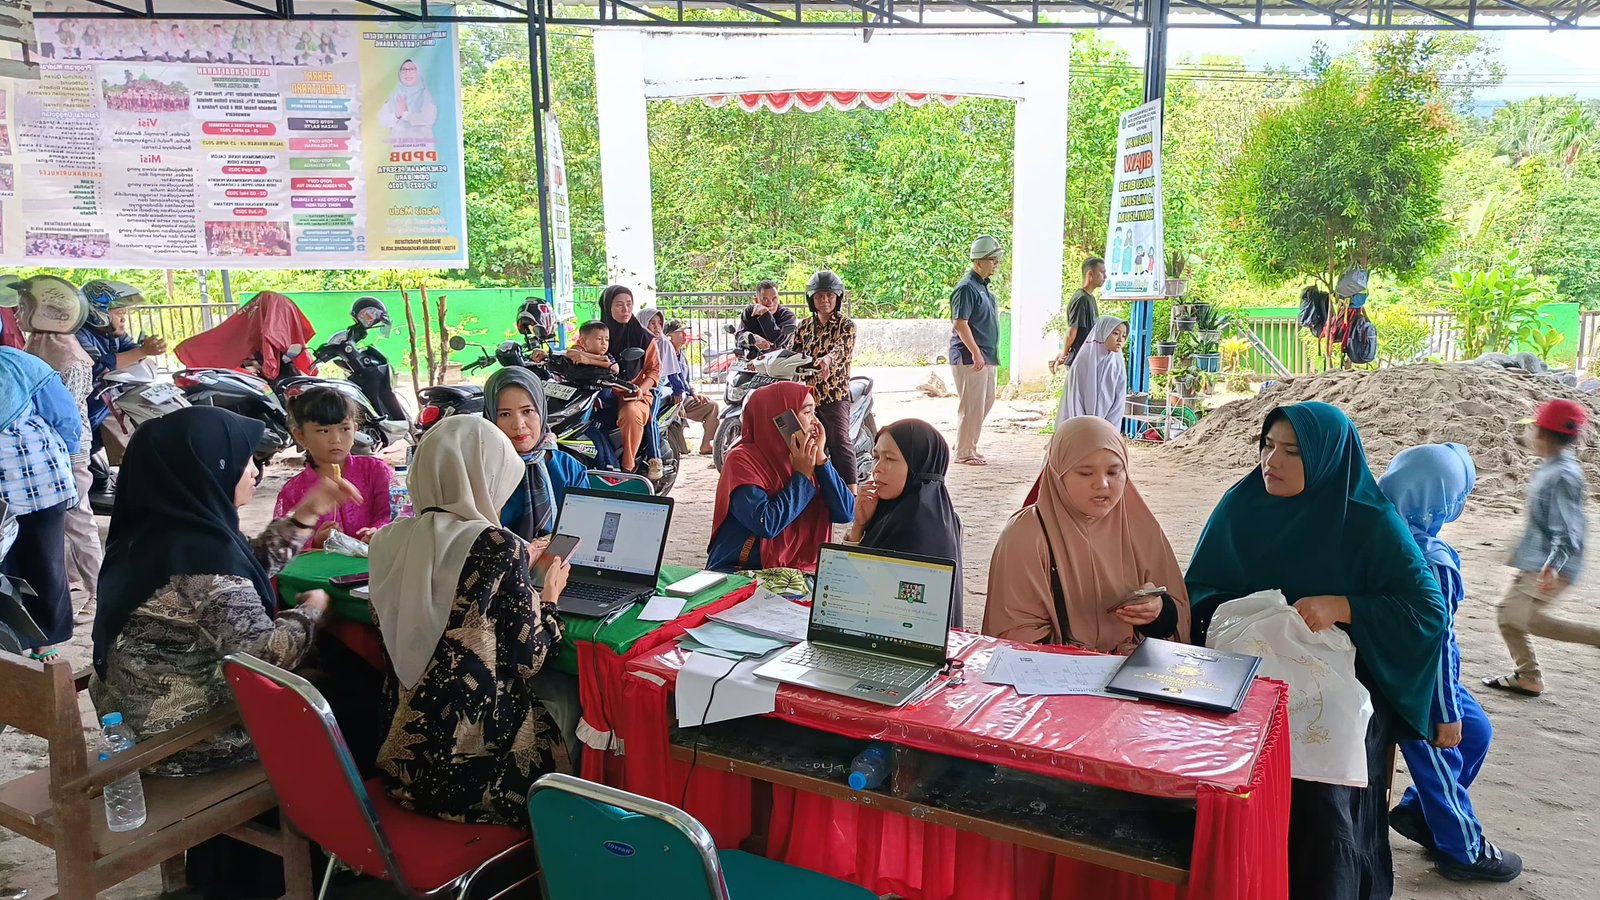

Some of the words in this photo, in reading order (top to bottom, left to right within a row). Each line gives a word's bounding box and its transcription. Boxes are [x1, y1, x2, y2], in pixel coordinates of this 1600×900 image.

[1124, 149, 1153, 174] WAJIB
[1121, 194, 1148, 207] MUSLIM
[1117, 208, 1154, 223] MUSLIMAH
